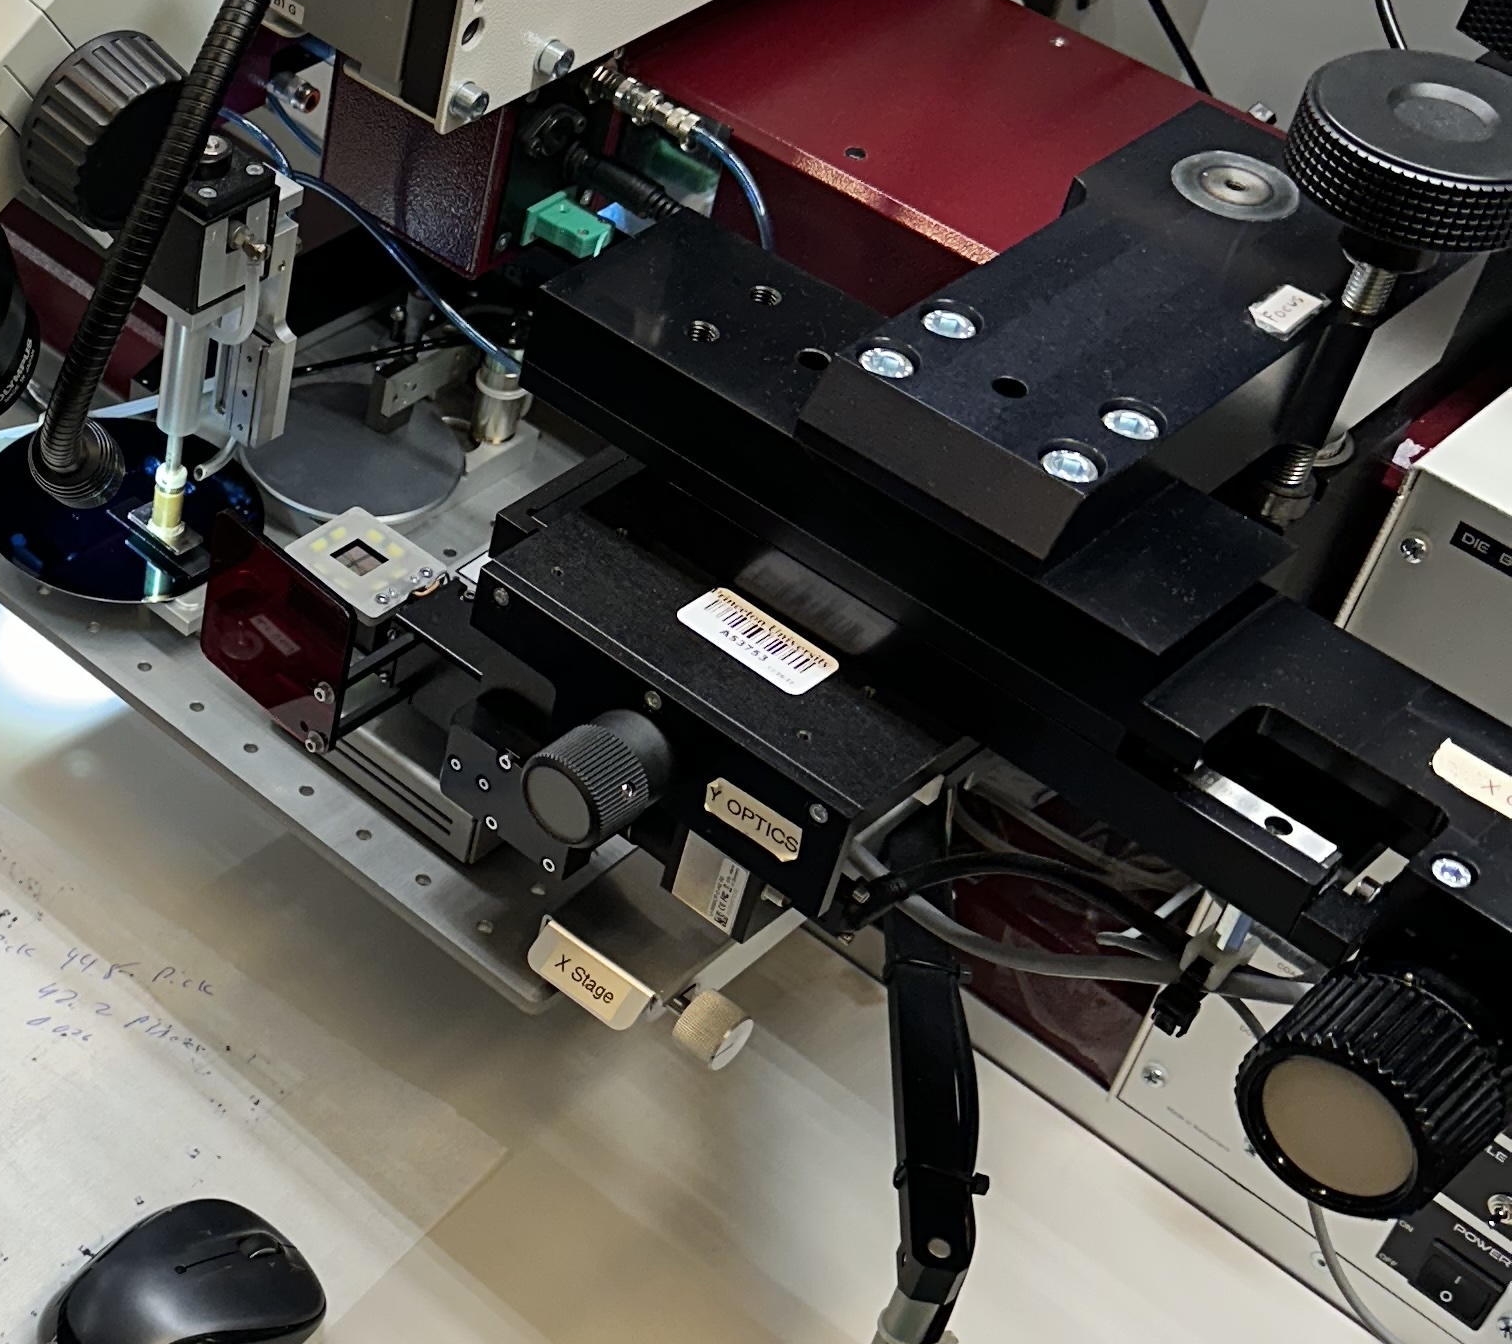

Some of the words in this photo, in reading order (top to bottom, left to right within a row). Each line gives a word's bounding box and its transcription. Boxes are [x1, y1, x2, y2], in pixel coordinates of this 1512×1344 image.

[1461, 531, 1491, 555] DIE
[711, 787, 722, 801] Y
[727, 799, 799, 853] OPTICS
[554, 953, 571, 972] X
[571, 966, 614, 1004] Stage
[1399, 1220, 1414, 1233] ON
[1453, 1223, 1512, 1268] POWER
